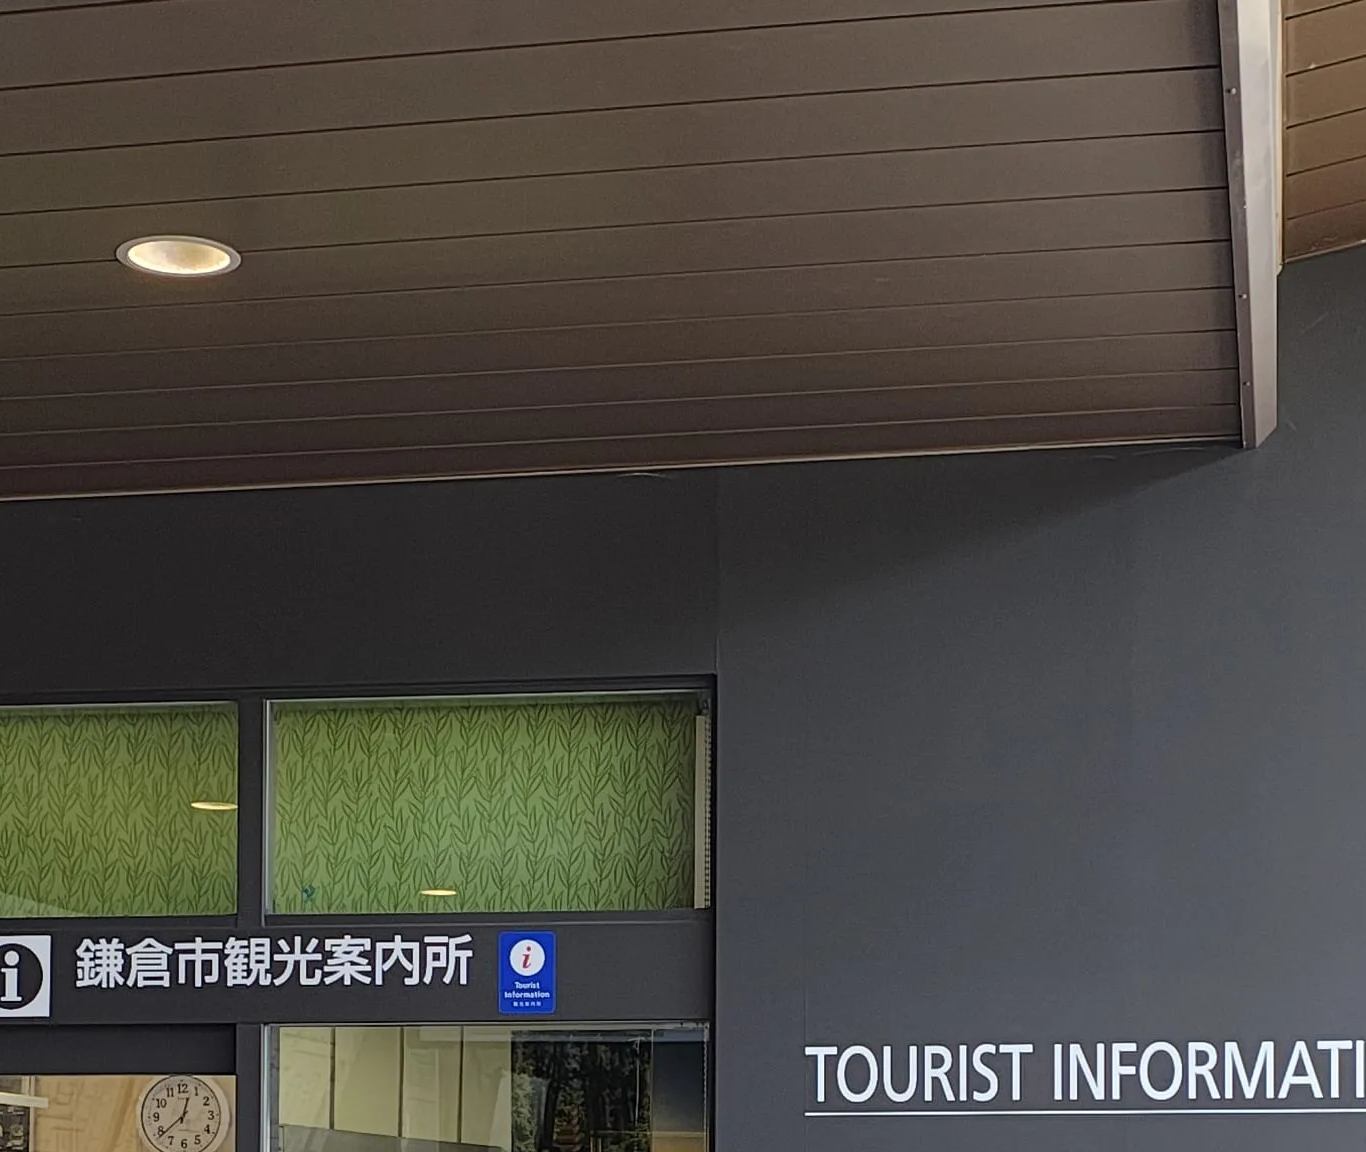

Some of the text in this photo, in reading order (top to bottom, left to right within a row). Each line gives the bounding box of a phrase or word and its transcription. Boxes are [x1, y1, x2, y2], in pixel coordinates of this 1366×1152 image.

[75, 934, 473, 987] 鎌倉市観光案内所
[805, 1042, 1034, 1103] TOURIST
[166, 1088, 174, 1098] 11
[177, 1084, 189, 1094] 12
[194, 1087, 199, 1096] 1
[156, 1098, 167, 1108] 10
[203, 1096, 210, 1106] 2
[153, 1112, 160, 1122] 9
[207, 1111, 215, 1120] 3
[157, 1126, 164, 1136] 8
[203, 1124, 210, 1134] 4
[167, 1136, 174, 1145] 7
[181, 1139, 188, 1149] 6
[194, 1135, 201, 1145] 5
